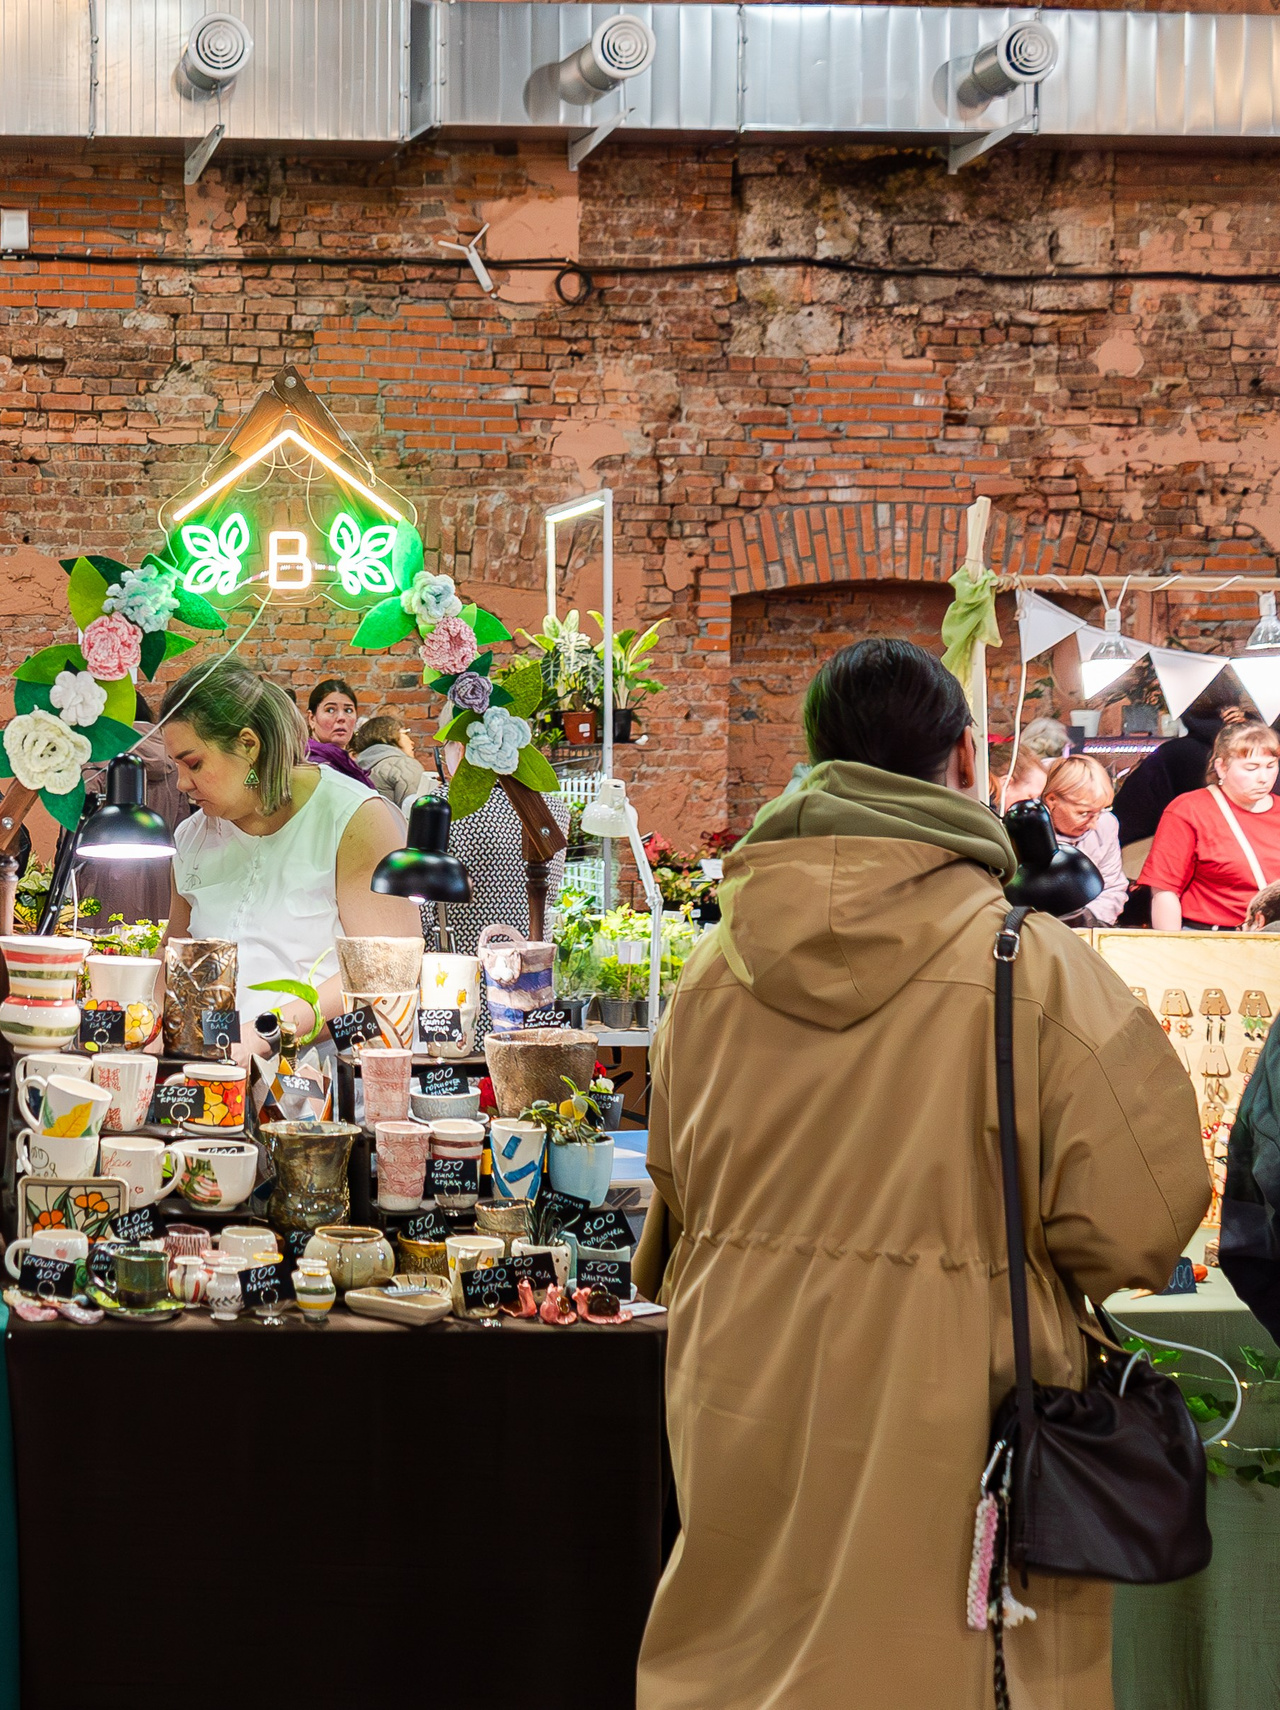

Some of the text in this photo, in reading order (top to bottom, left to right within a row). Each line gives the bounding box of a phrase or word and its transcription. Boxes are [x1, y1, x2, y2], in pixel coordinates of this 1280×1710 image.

[333, 1010, 365, 1030] 900
[419, 1010, 453, 1021] 1000
[526, 1010, 565, 1023] 1400
[426, 1067, 454, 1084] 900
[156, 1086, 198, 1098] 1500
[434, 1159, 464, 1172] 950
[117, 1209, 150, 1233] 1200
[408, 1213, 435, 1237] 850
[583, 1212, 616, 1235] 800
[250, 1265, 276, 1283] 800
[472, 1268, 507, 1285] 900
[585, 1261, 620, 1275] 500
